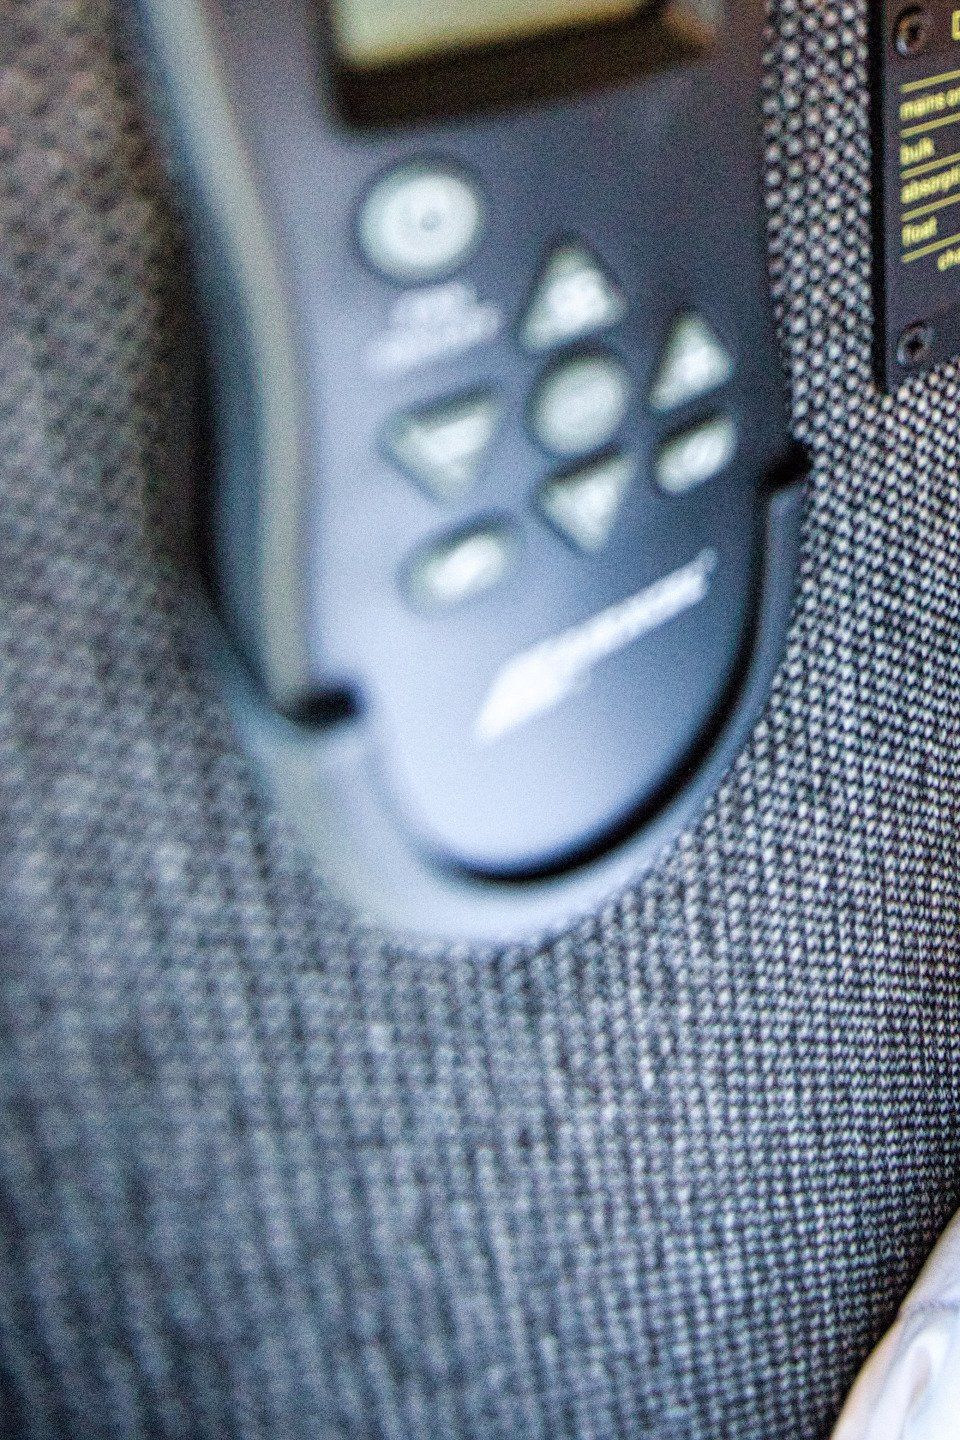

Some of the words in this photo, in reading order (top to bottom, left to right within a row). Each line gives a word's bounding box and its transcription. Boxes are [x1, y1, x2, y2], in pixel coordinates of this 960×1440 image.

[900, 92, 946, 121] mains
[900, 137, 935, 166] bulk
[902, 216, 938, 247] float
